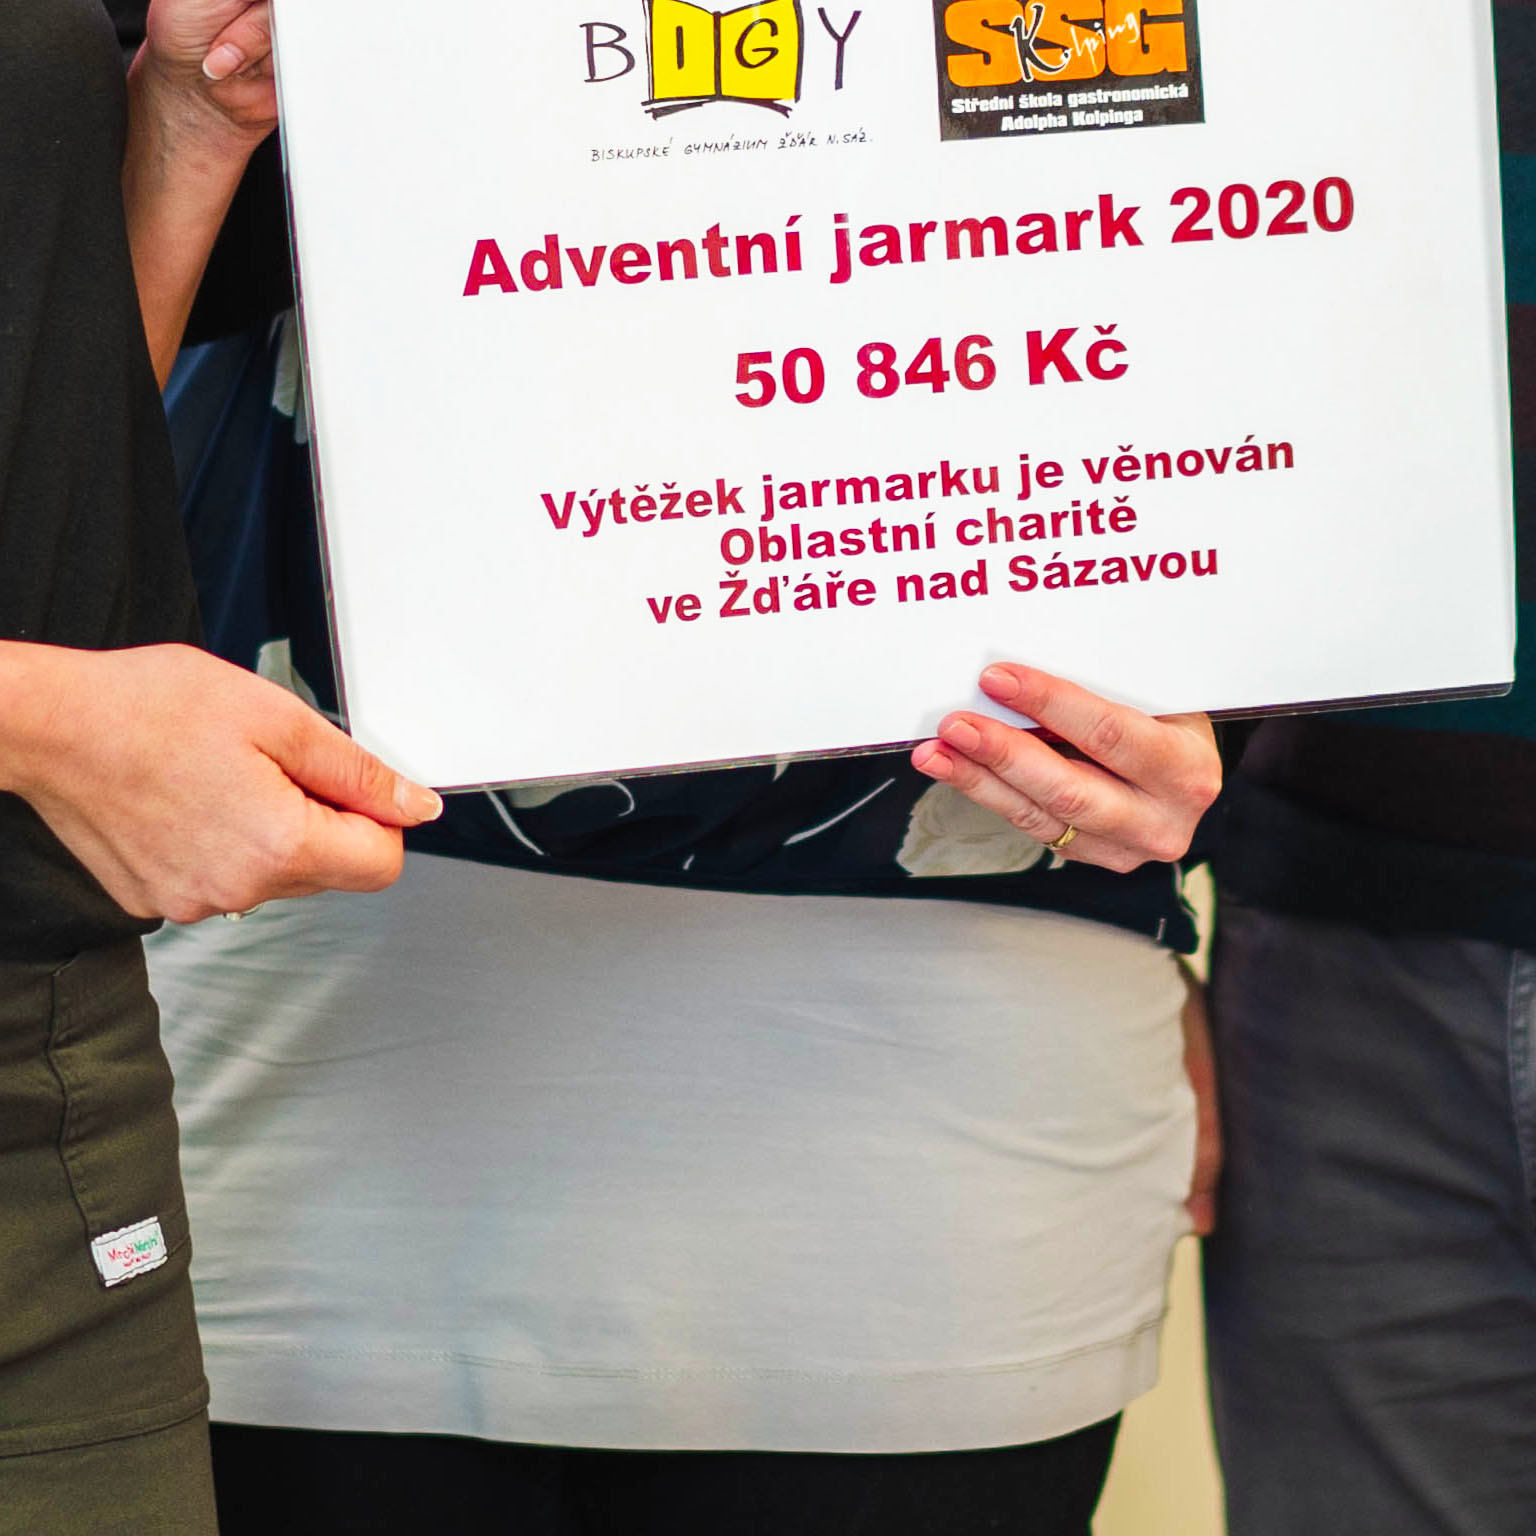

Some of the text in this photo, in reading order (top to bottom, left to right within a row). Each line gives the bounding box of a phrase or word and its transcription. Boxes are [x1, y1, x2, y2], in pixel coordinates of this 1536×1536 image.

[579, 7, 862, 90] BIGY
[951, 83, 1189, 114] Střední škola gastronomická
[1001, 109, 1145, 132] Adolpha Kolpinga
[591, 137, 673, 162] BISKUPSKÉ
[684, 133, 768, 155] GYMNÁZIUM
[463, 177, 1354, 296] Adventní jarmark 2020
[736, 324, 1129, 408] 50 846 Kč
[541, 435, 1294, 537] Výtěžek jarmarku je věnován
[720, 496, 1137, 566] Oblastní charitě
[647, 544, 1218, 624] ve Žďáře nad Sázavou
